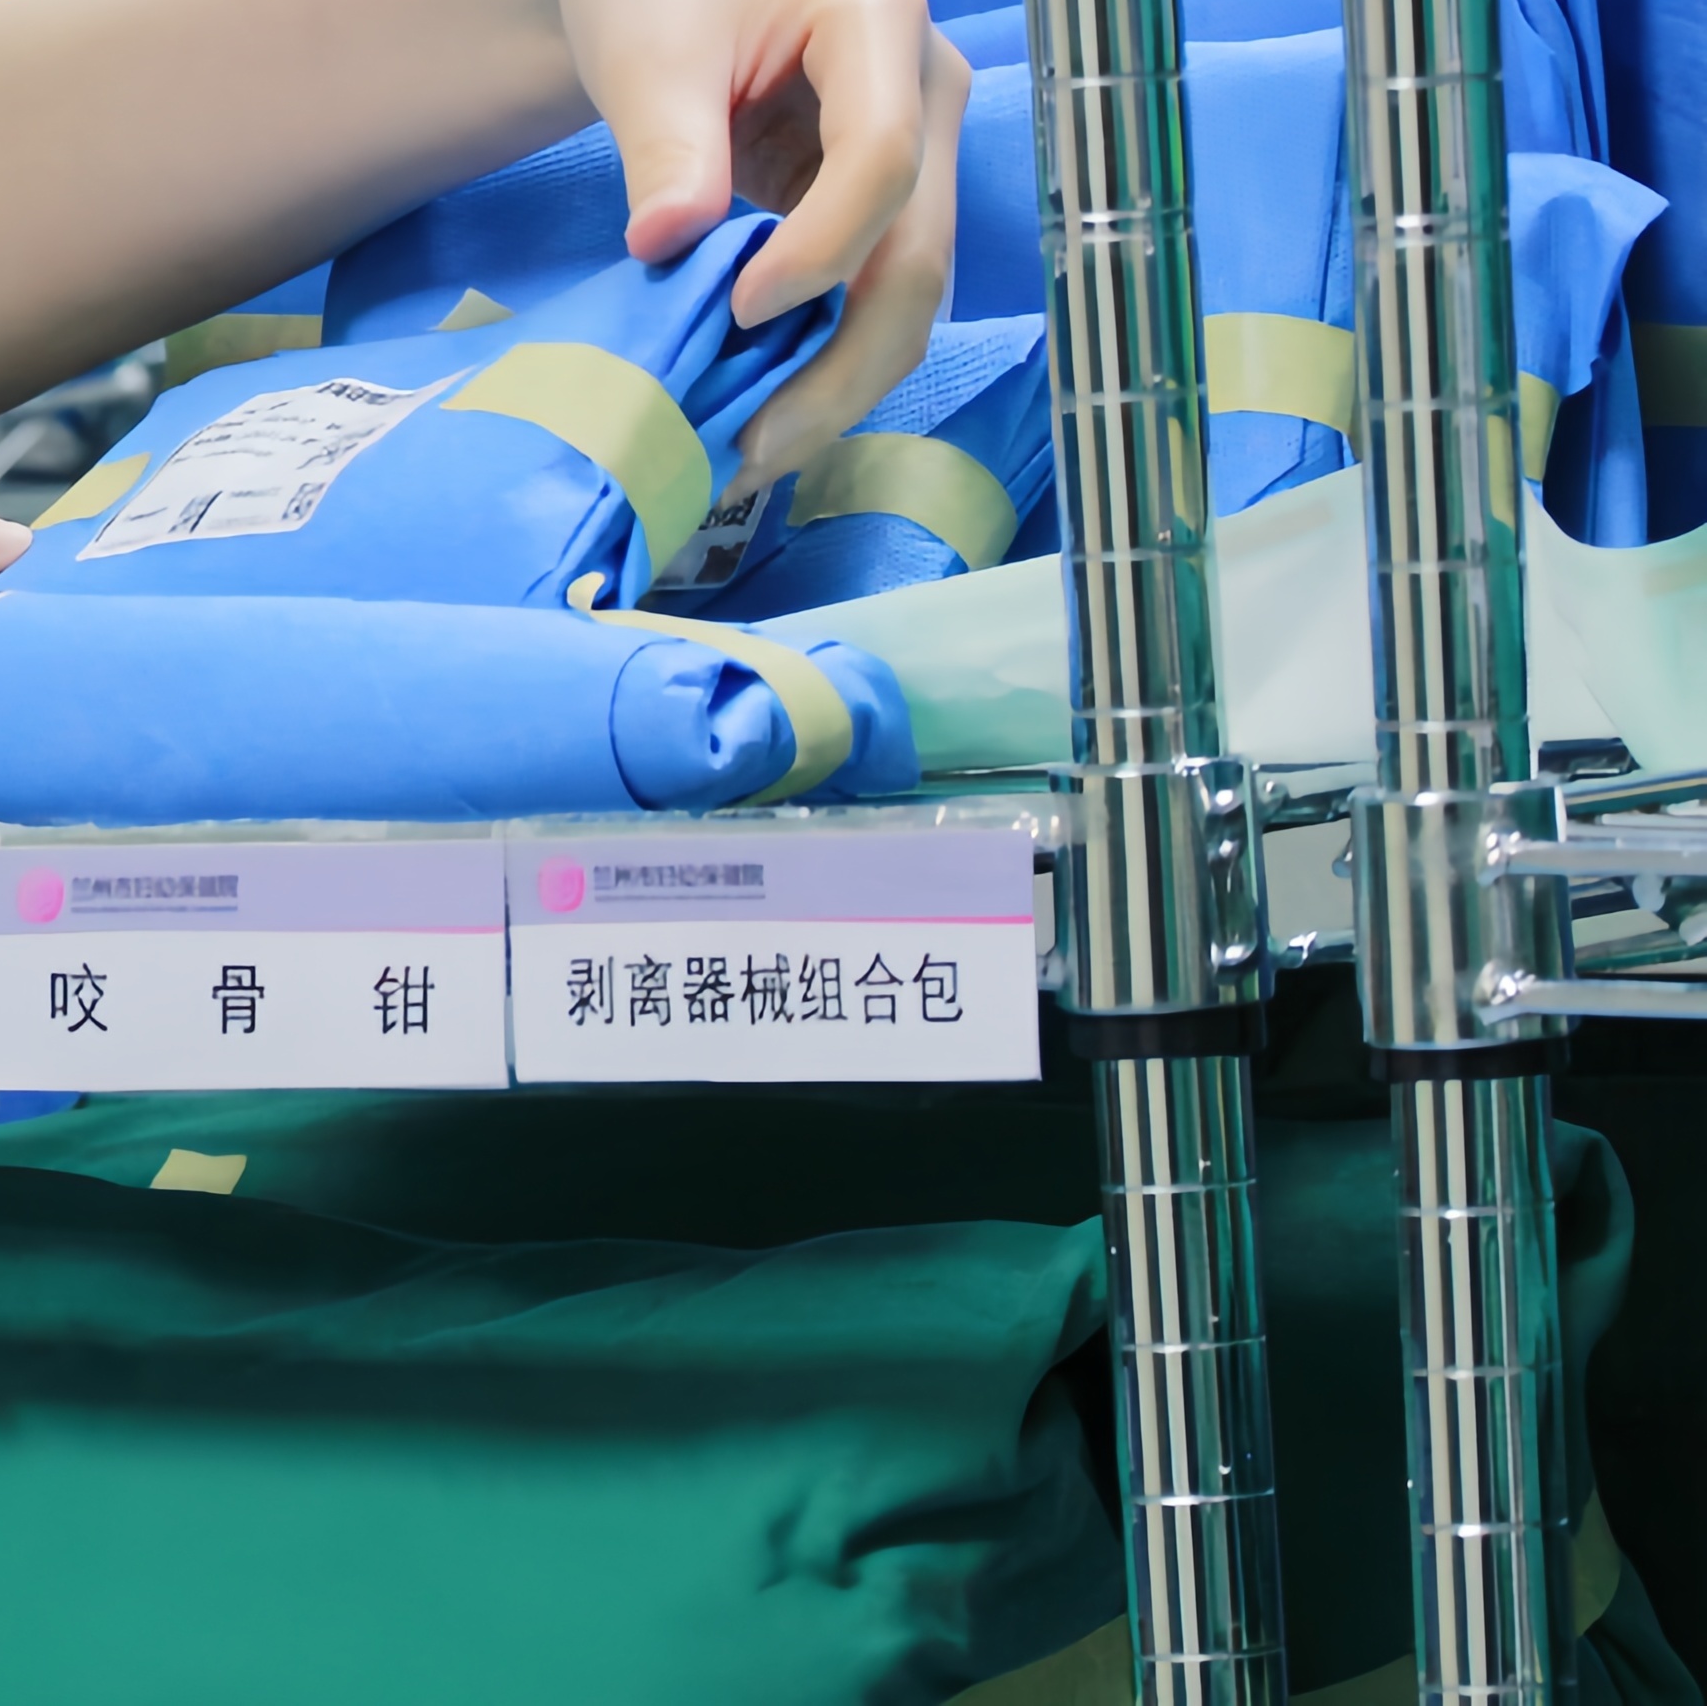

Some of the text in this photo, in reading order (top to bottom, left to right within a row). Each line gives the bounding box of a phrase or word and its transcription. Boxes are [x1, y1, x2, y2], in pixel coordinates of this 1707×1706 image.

[49, 963, 435, 1035] 咬骨钳
[567, 953, 963, 1026] 剥离器械组合包
